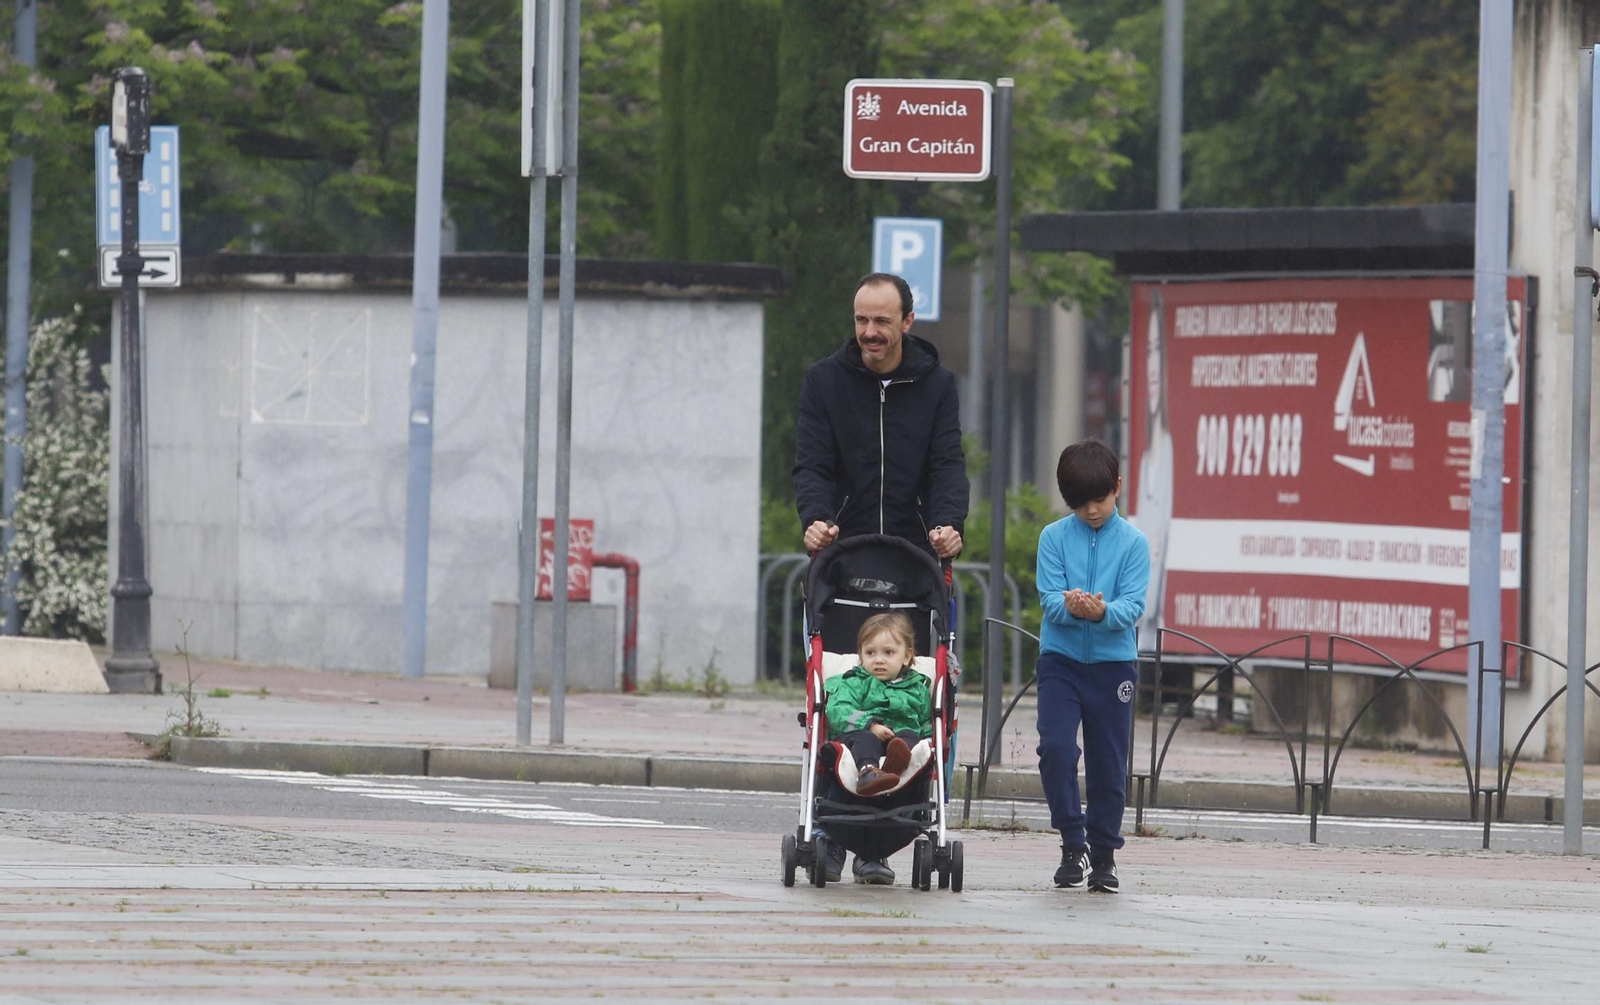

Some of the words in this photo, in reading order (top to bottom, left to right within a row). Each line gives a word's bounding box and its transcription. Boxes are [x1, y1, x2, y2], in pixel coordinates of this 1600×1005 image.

[896, 99, 968, 117] Avenida
[859, 136, 901, 153] Gran
[907, 137, 975, 157] Capitán
[890, 230, 925, 274] P
[1308, 301, 1338, 335] GASTOS
[1284, 352, 1318, 386] CLIENTES
[1196, 414, 1229, 477] 900
[1232, 413, 1265, 478] 929
[1268, 413, 1303, 477] 888
[1174, 593, 1198, 627] 100%
[1198, 588, 1262, 629] FINANCIACIÓN
